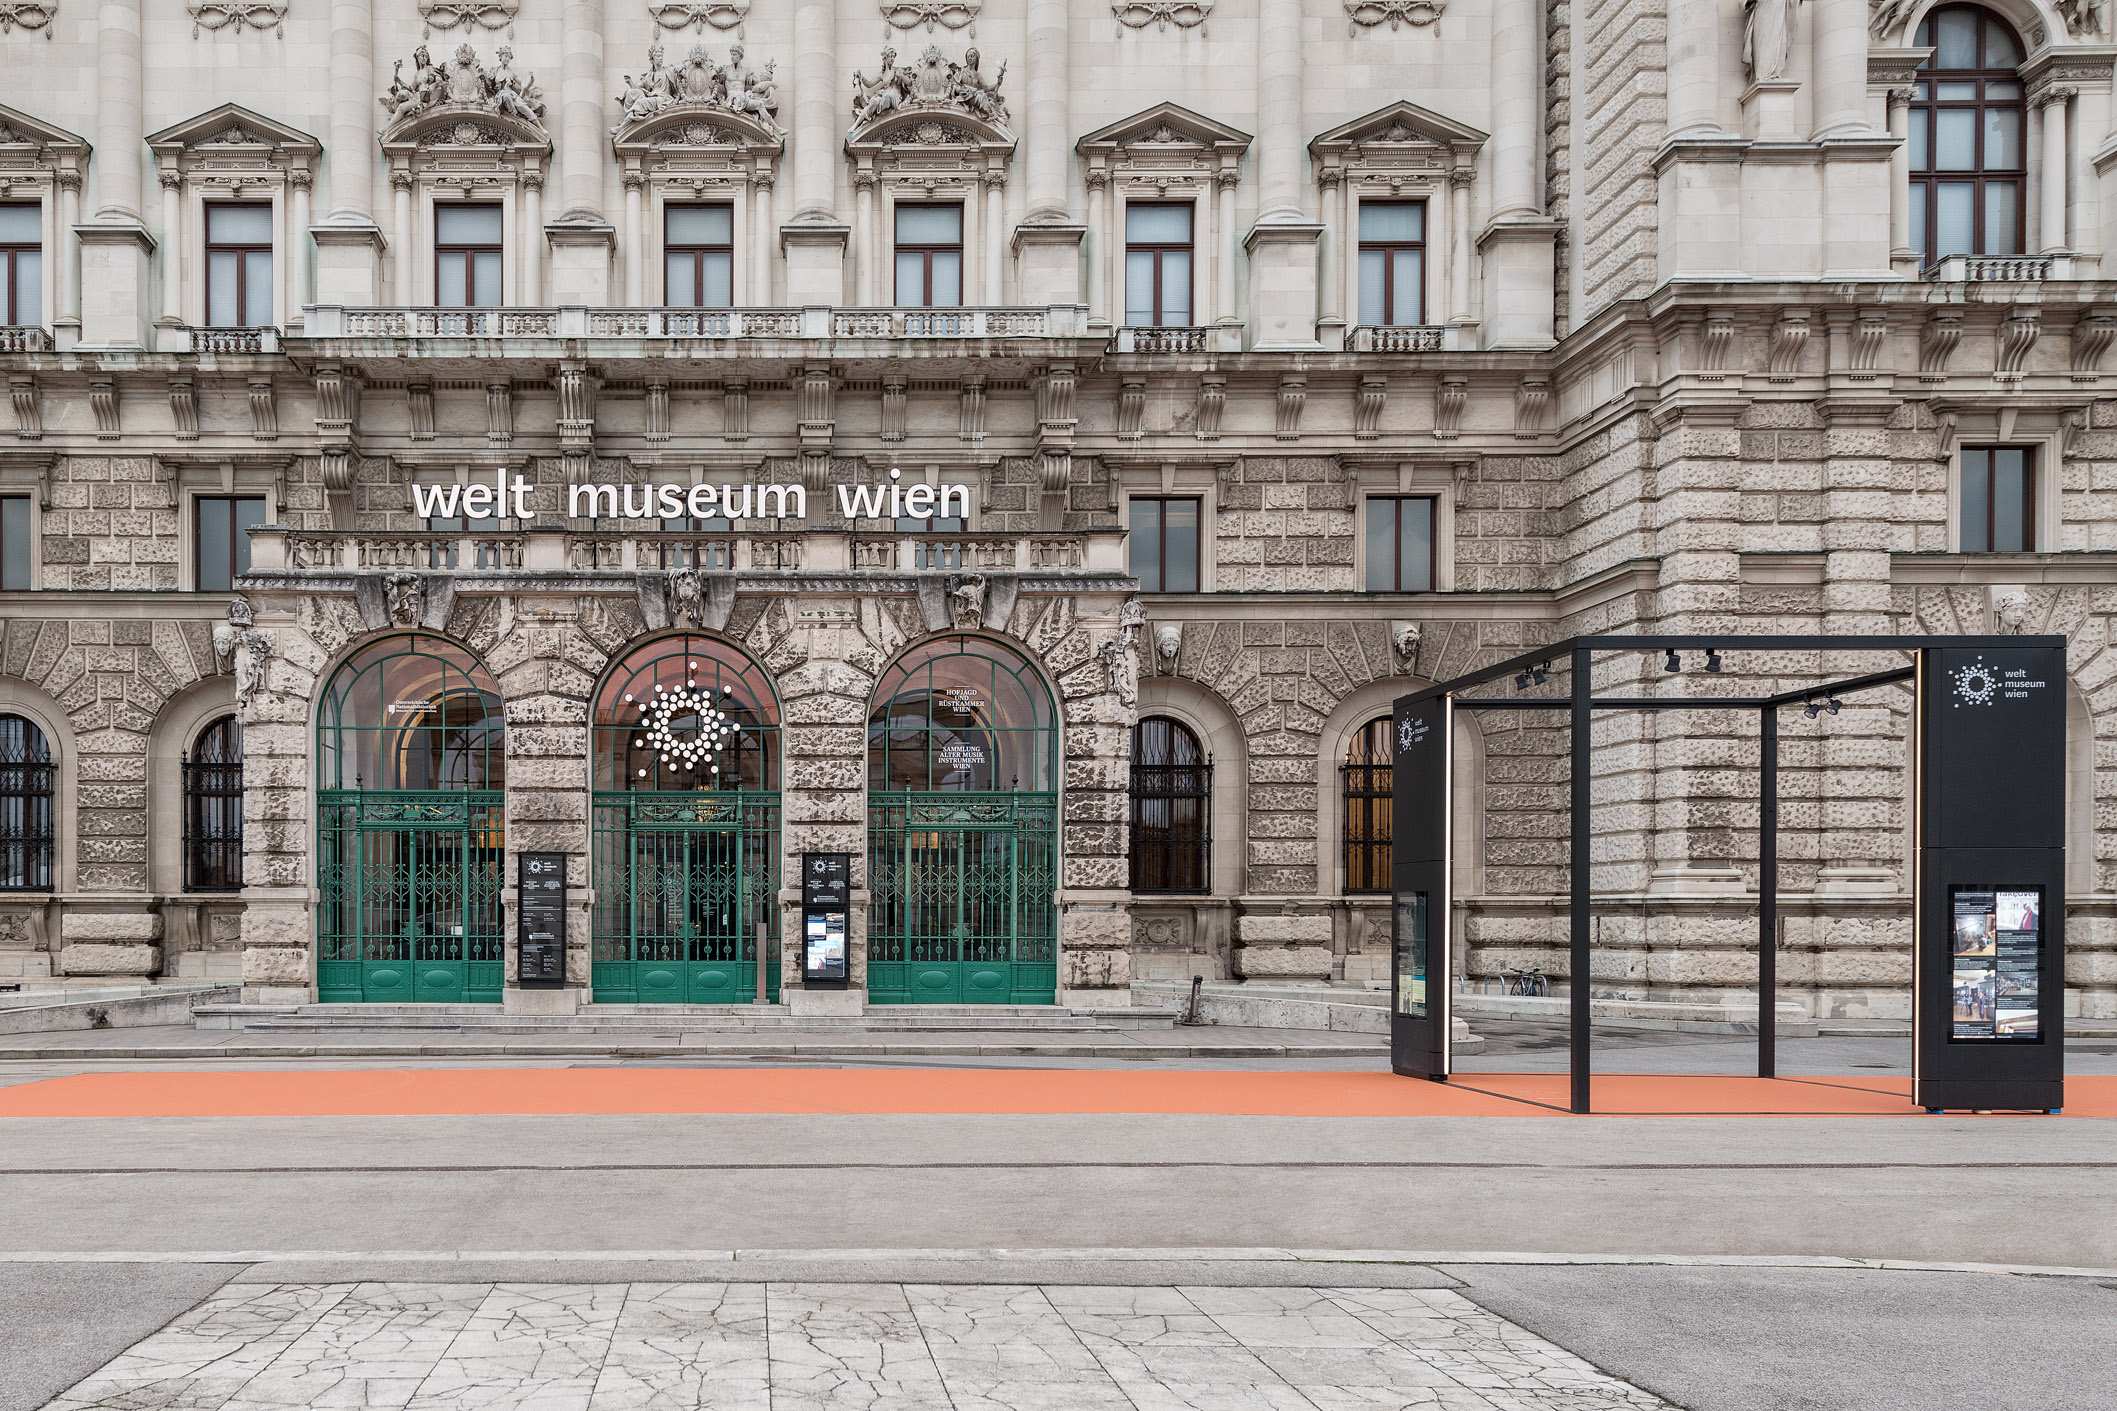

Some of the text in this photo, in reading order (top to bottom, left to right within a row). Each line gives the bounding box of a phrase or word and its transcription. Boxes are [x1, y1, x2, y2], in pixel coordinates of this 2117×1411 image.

[411, 468, 969, 519] welt museum wien
[2005, 668, 2026, 677] welt
[2005, 689, 2028, 697] wien
